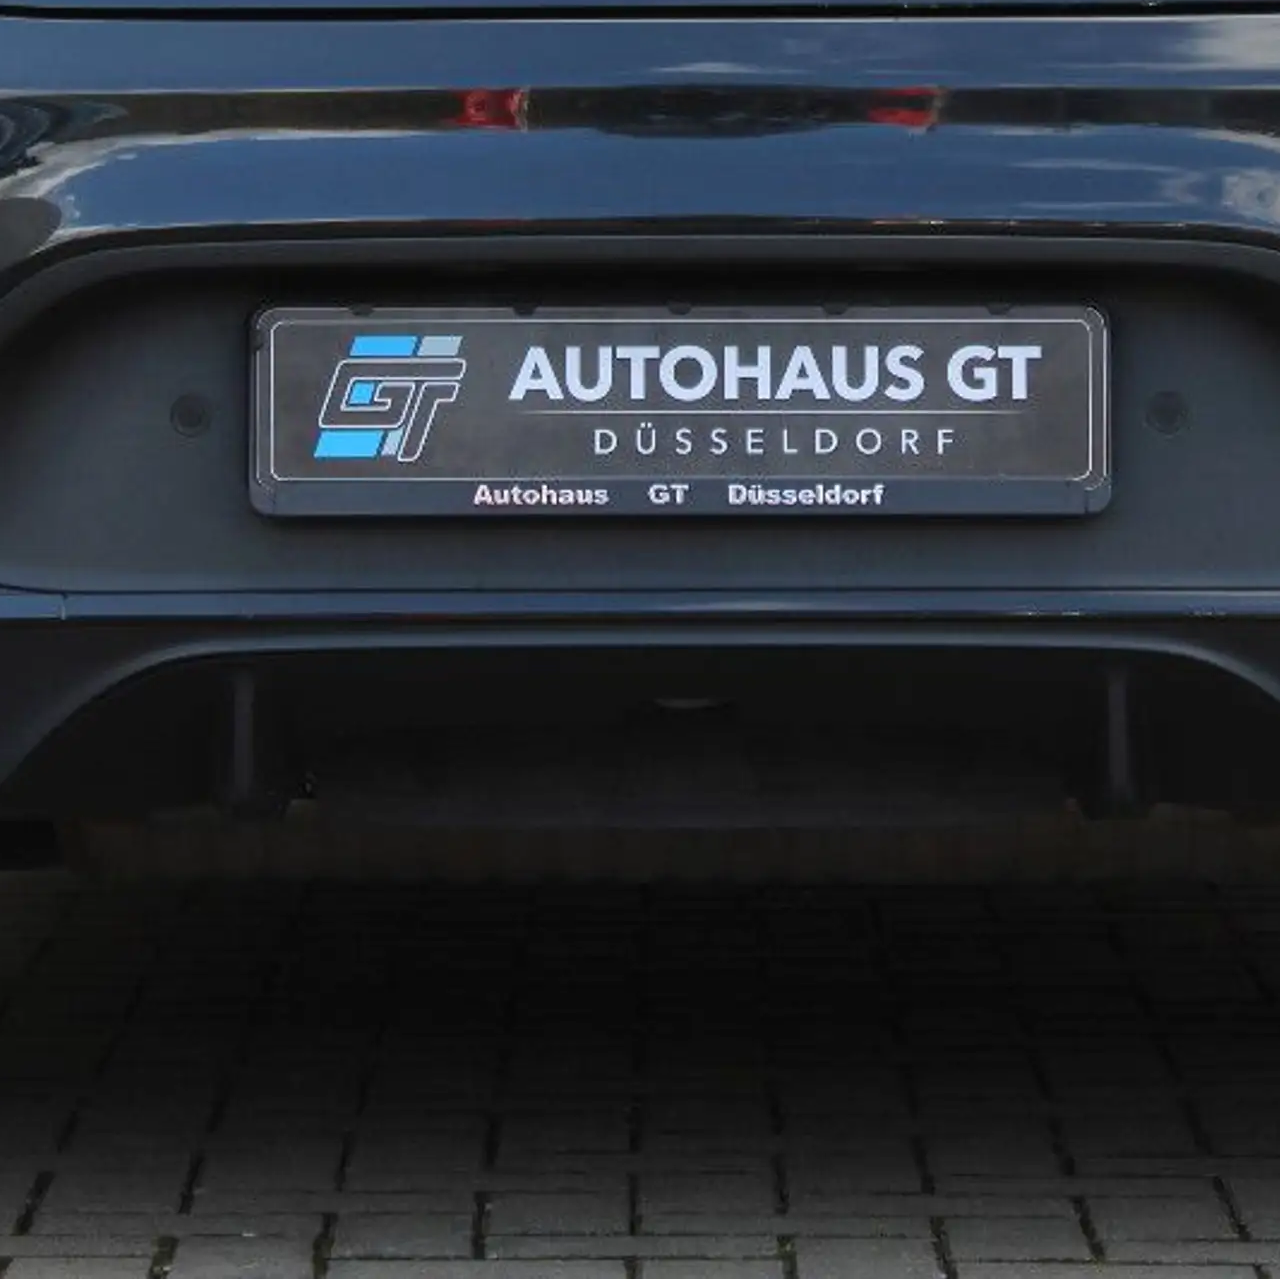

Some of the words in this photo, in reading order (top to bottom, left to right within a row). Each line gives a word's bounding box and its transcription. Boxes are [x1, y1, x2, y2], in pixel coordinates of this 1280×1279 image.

[508, 344, 925, 402] AUTOHAUS
[947, 344, 1042, 402] GT
[594, 422, 955, 455] DÜSSELDORF
[473, 484, 610, 505] Autohaus
[647, 483, 690, 505] GT
[727, 483, 885, 506] Düsseldorf
